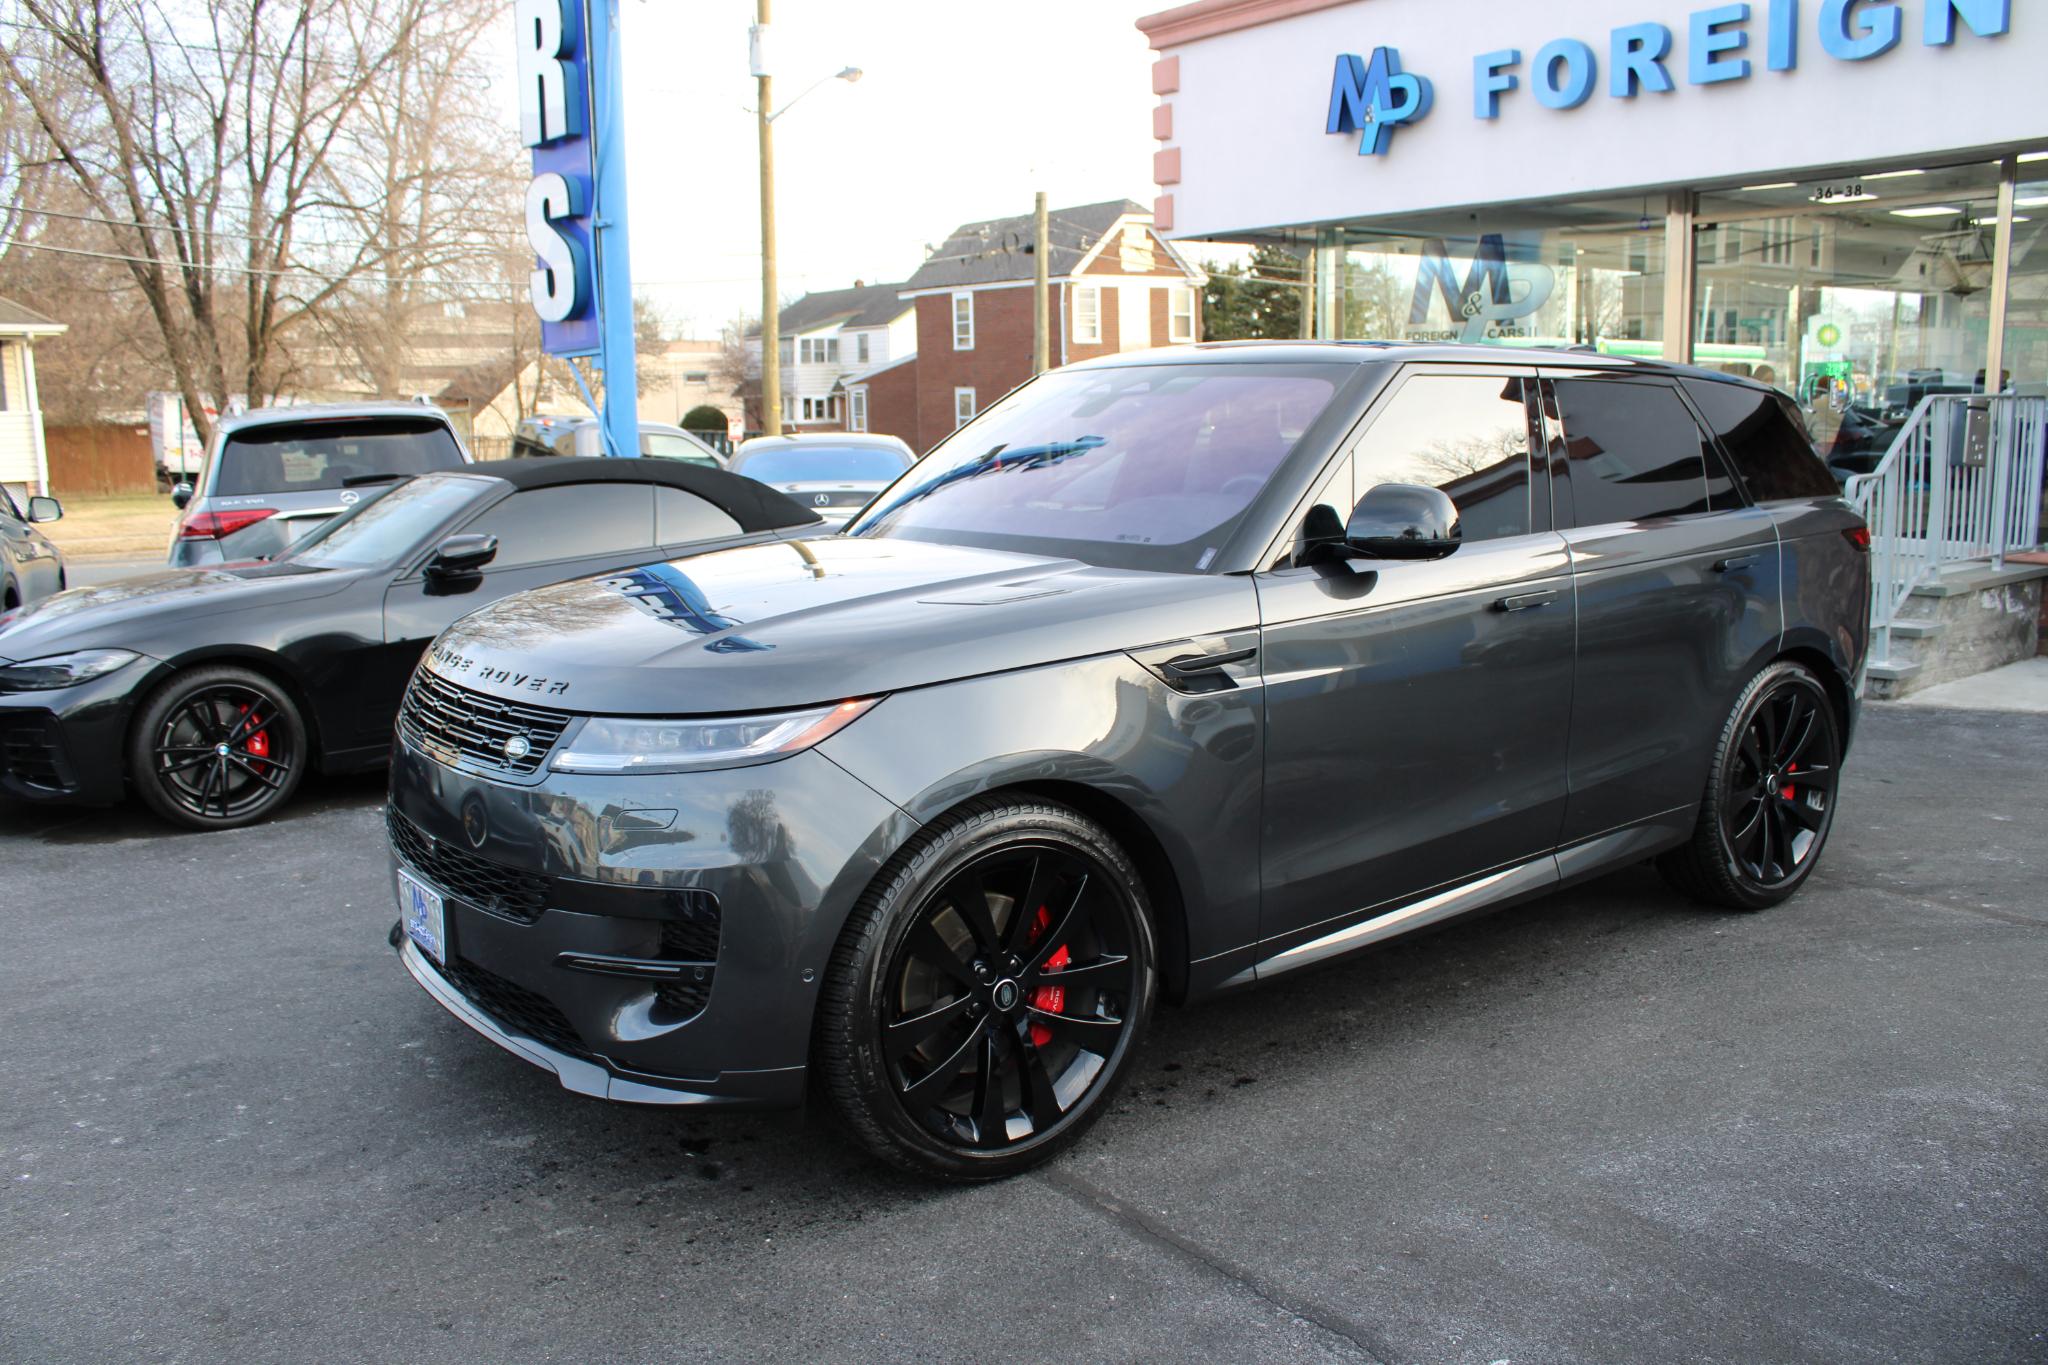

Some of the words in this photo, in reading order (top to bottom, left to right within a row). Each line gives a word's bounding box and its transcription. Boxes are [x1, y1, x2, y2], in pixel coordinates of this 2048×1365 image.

[1815, 184, 1862, 199] 36-38
[1405, 330, 1459, 343] FOREIGN
[1487, 327, 1525, 339] CARS
[479, 667, 570, 695] ROVER
